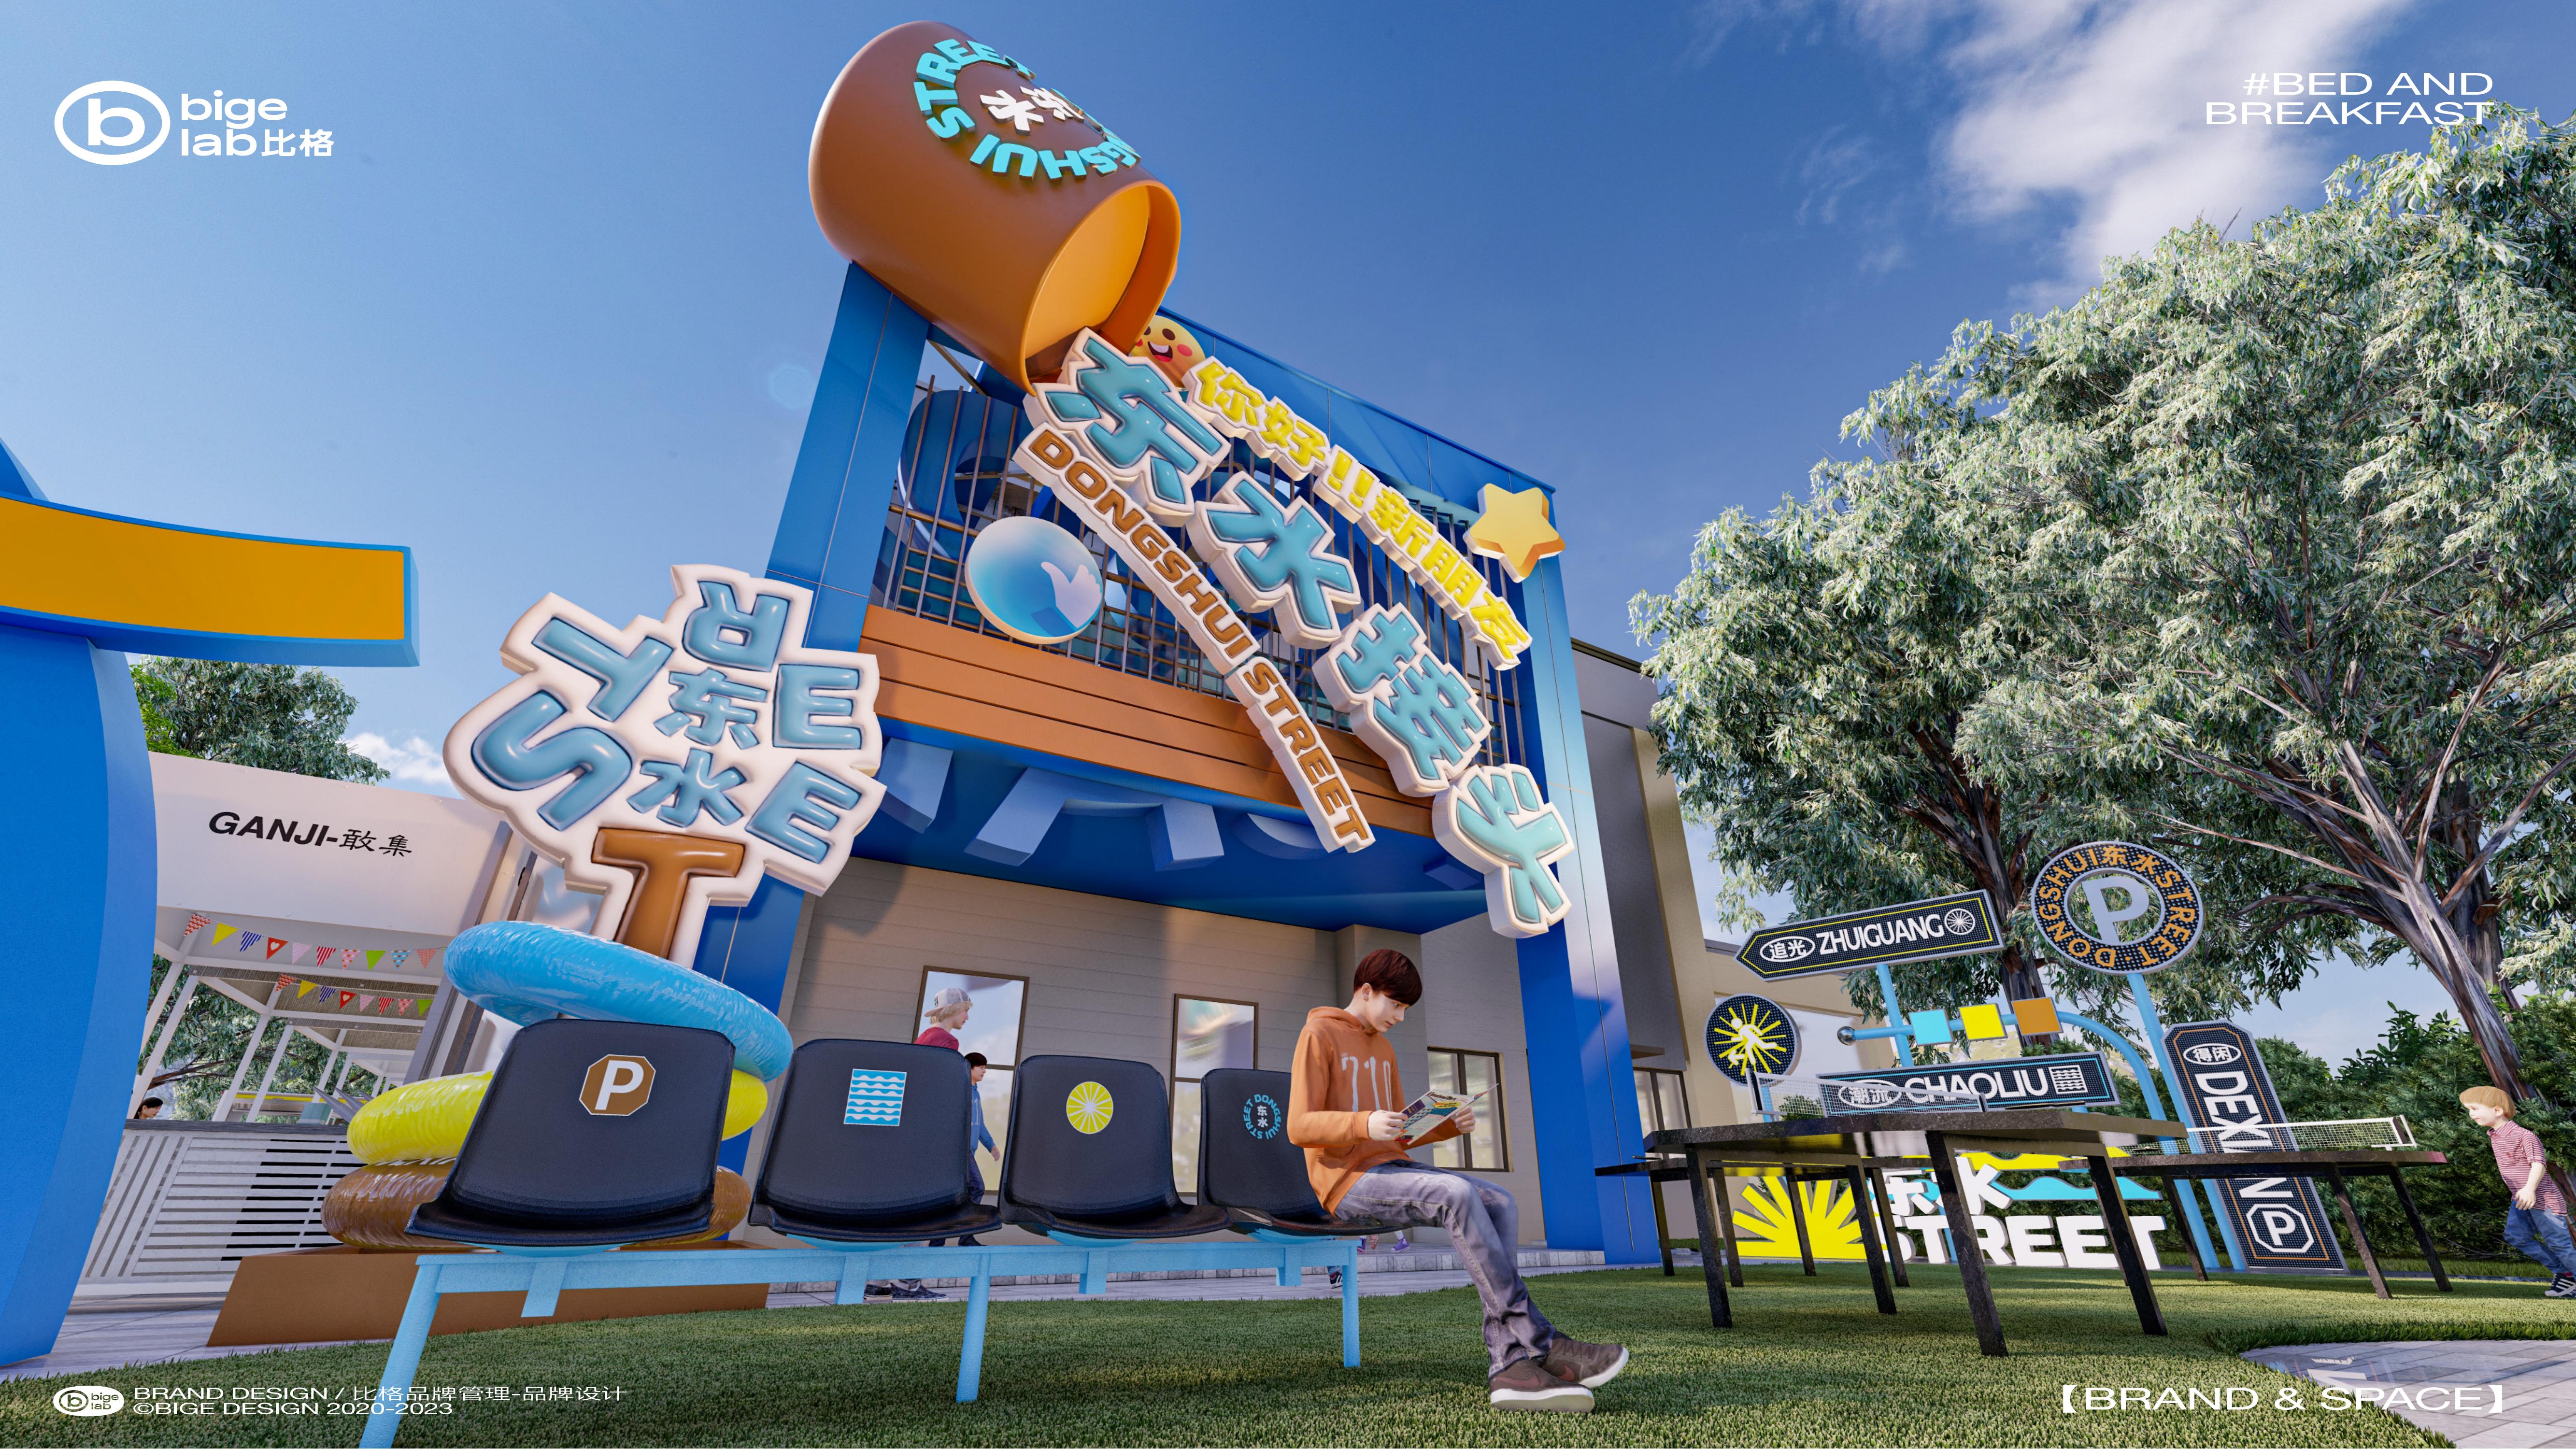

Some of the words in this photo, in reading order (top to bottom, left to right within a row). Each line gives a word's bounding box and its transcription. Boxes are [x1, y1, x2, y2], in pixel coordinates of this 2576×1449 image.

[1030, 429, 1252, 659] DONGSHUI
[1243, 662, 1370, 841] STREET
[1045, 337, 1567, 924] 东水接头
[626, 668, 768, 827] 东水
[2038, 848, 2117, 968] DONGSHUI
[2101, 846, 2161, 875] 东水
[2138, 870, 2195, 967] STREET
[2081, 875, 2150, 945] P
[1769, 939, 1807, 960] 追光
[1816, 913, 1945, 955] ZHUIGUANG
[2192, 1046, 2233, 1063] 得闲
[594, 1059, 644, 1111] P
[1904, 1068, 2049, 1103] CHAOLIU
[1243, 1098, 1264, 1140] STREET
[1254, 1094, 1281, 1140] DONGSHUI
[1256, 1104, 1268, 1128] 东水
[2194, 1070, 2294, 1198] DEXIN
[2262, 1210, 2296, 1246] P
